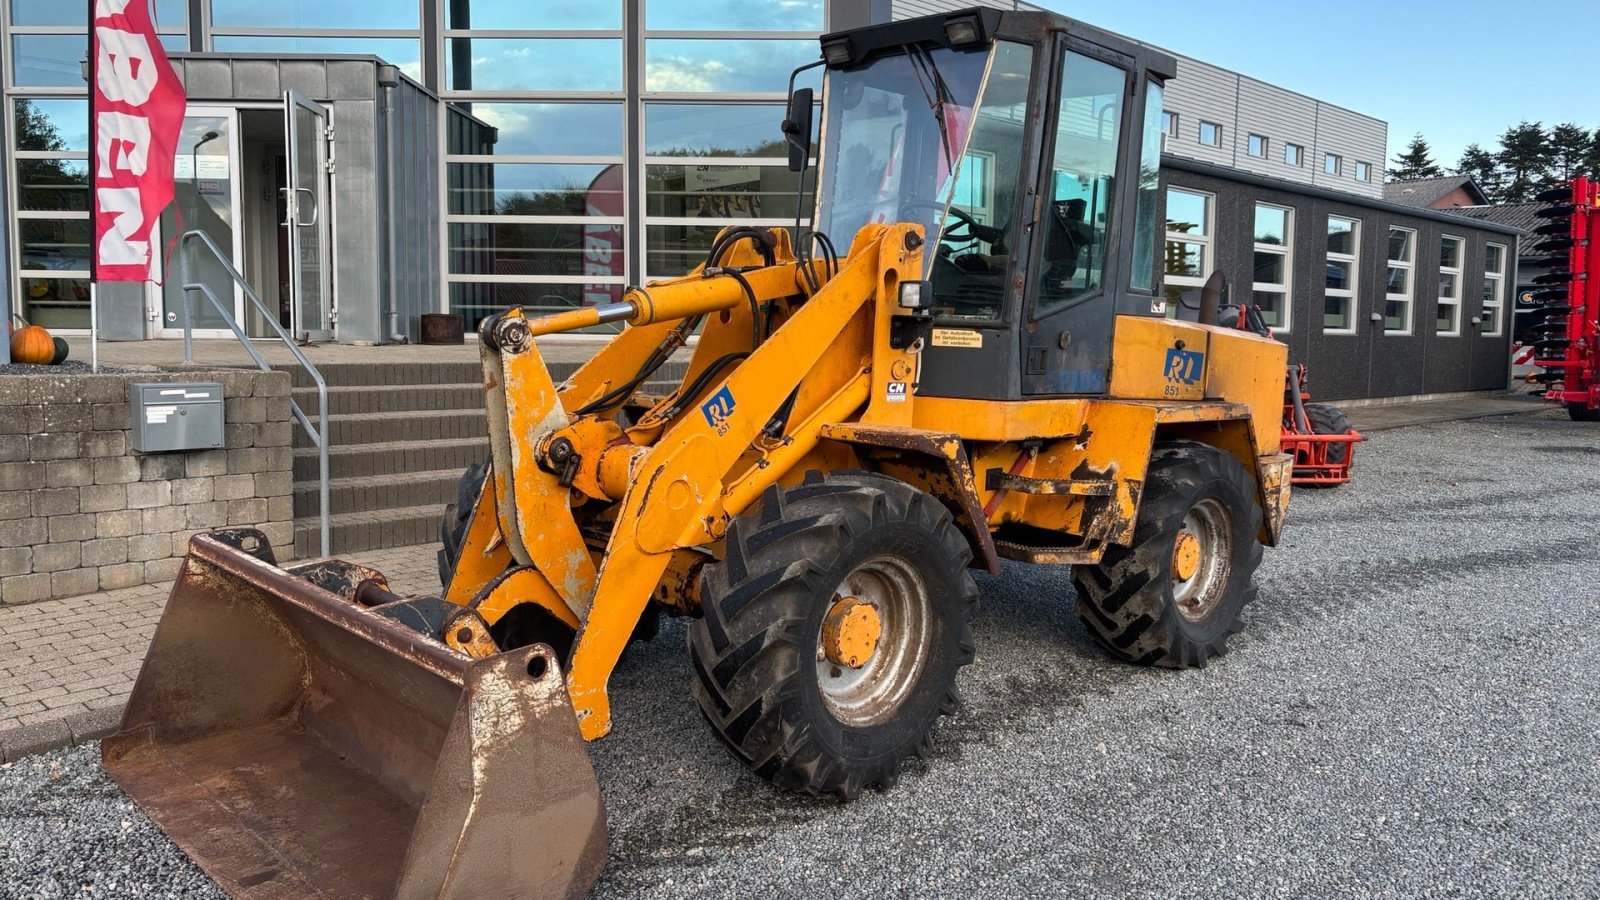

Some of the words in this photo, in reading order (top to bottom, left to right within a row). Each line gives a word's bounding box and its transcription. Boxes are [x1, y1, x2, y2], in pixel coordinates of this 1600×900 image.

[95, 0, 158, 265] BEN
[888, 382, 905, 393] CN
[1164, 385, 1180, 397] 851
[717, 422, 731, 437] 851
